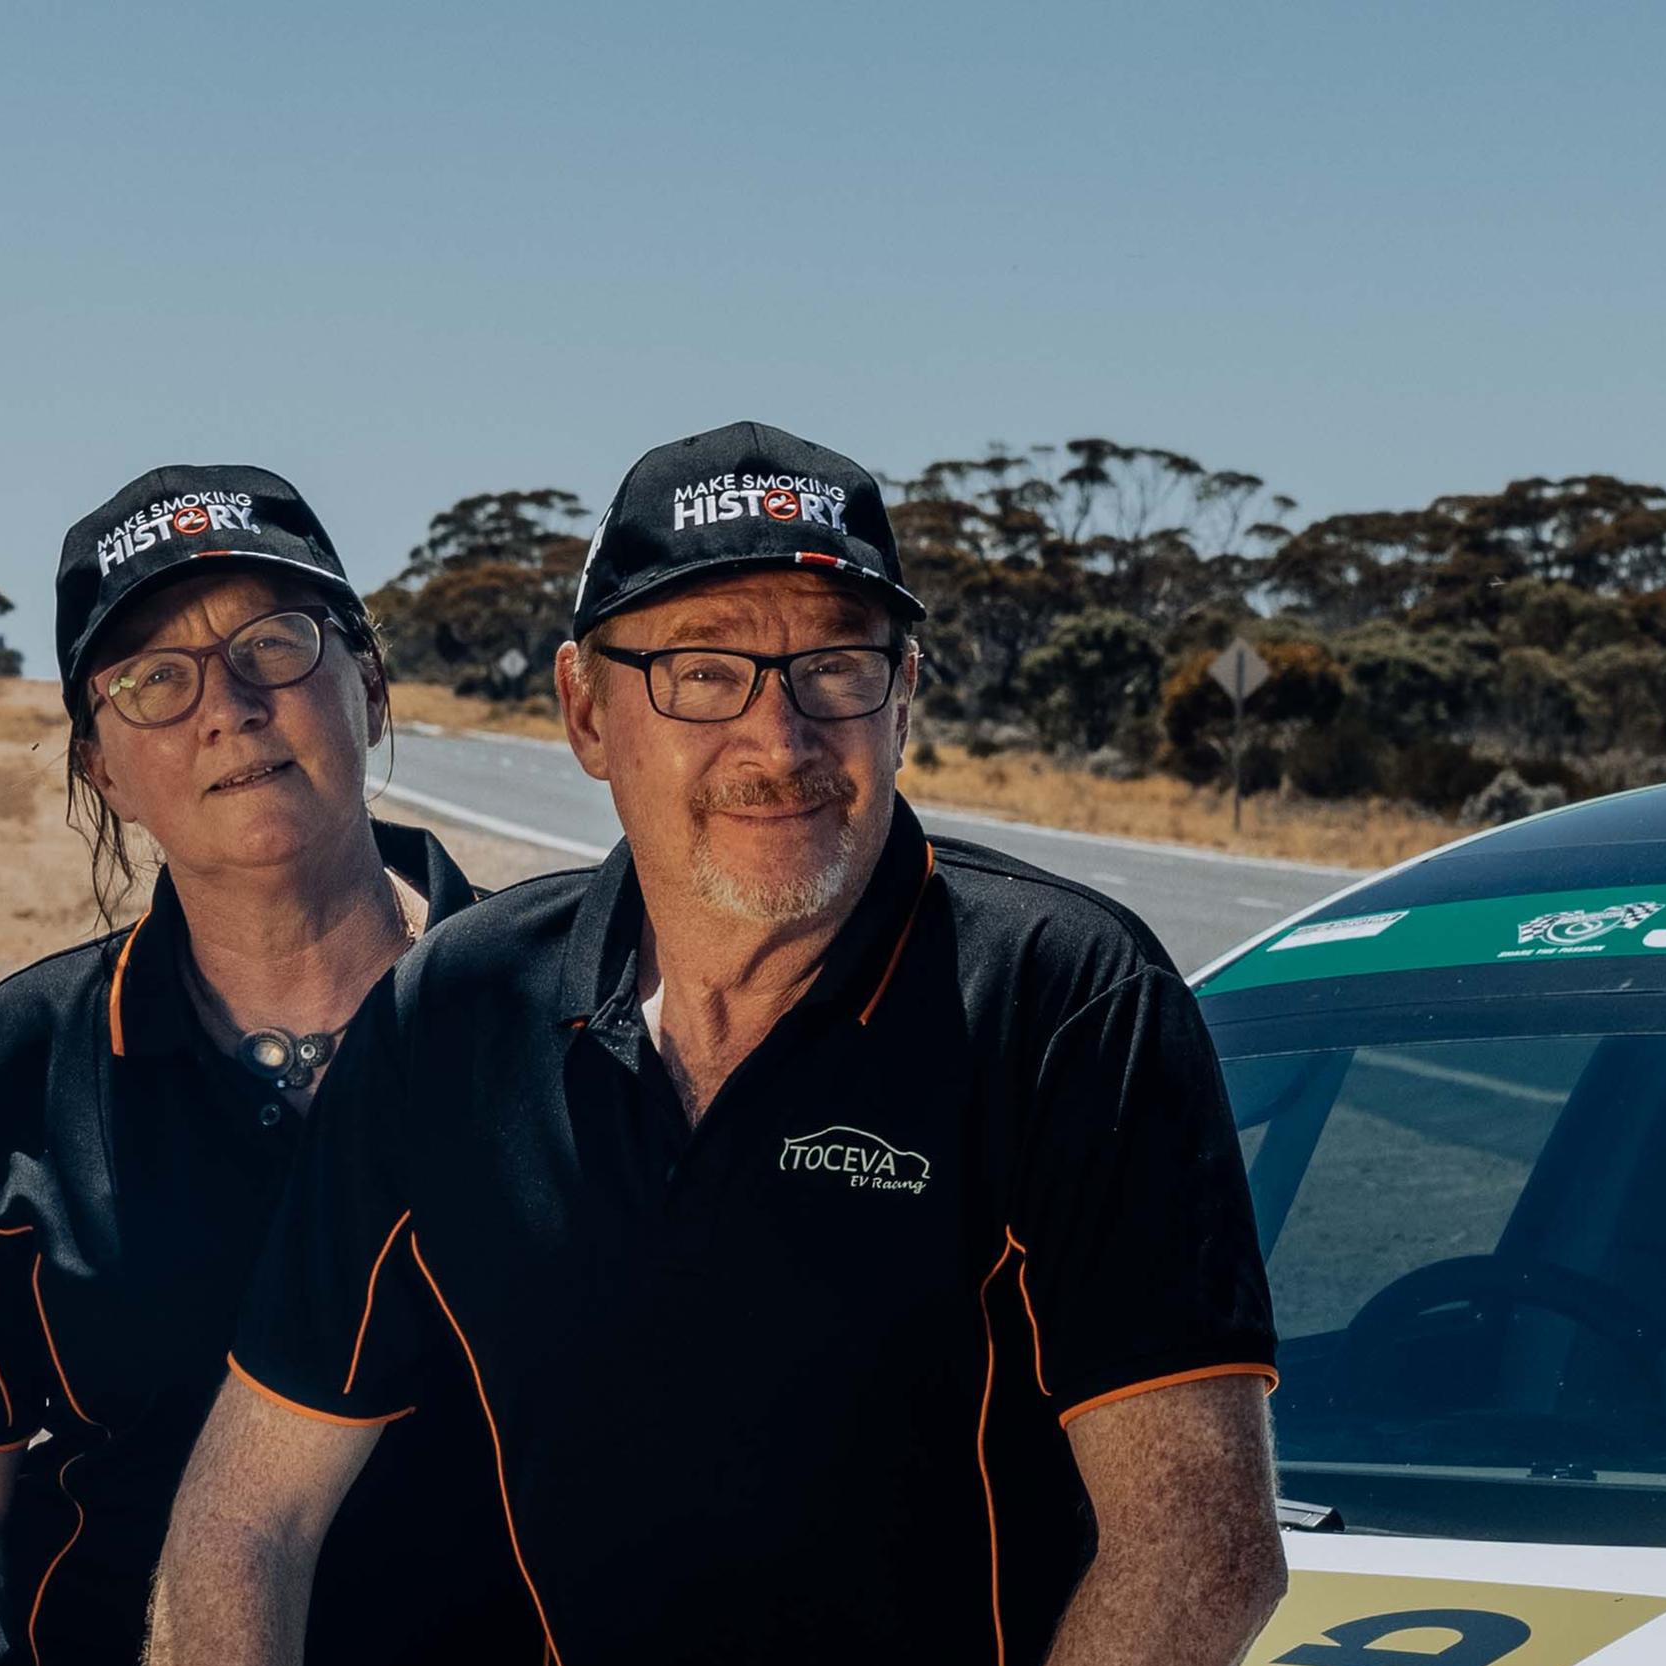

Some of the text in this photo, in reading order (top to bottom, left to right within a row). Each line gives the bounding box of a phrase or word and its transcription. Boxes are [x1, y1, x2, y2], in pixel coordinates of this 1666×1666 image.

[673, 473, 846, 503] MAKE SMOKING
[96, 491, 252, 553] MAKE SMOKING
[789, 1144, 896, 1176] TOCEVA
[850, 1175, 927, 1195] EV Racing
